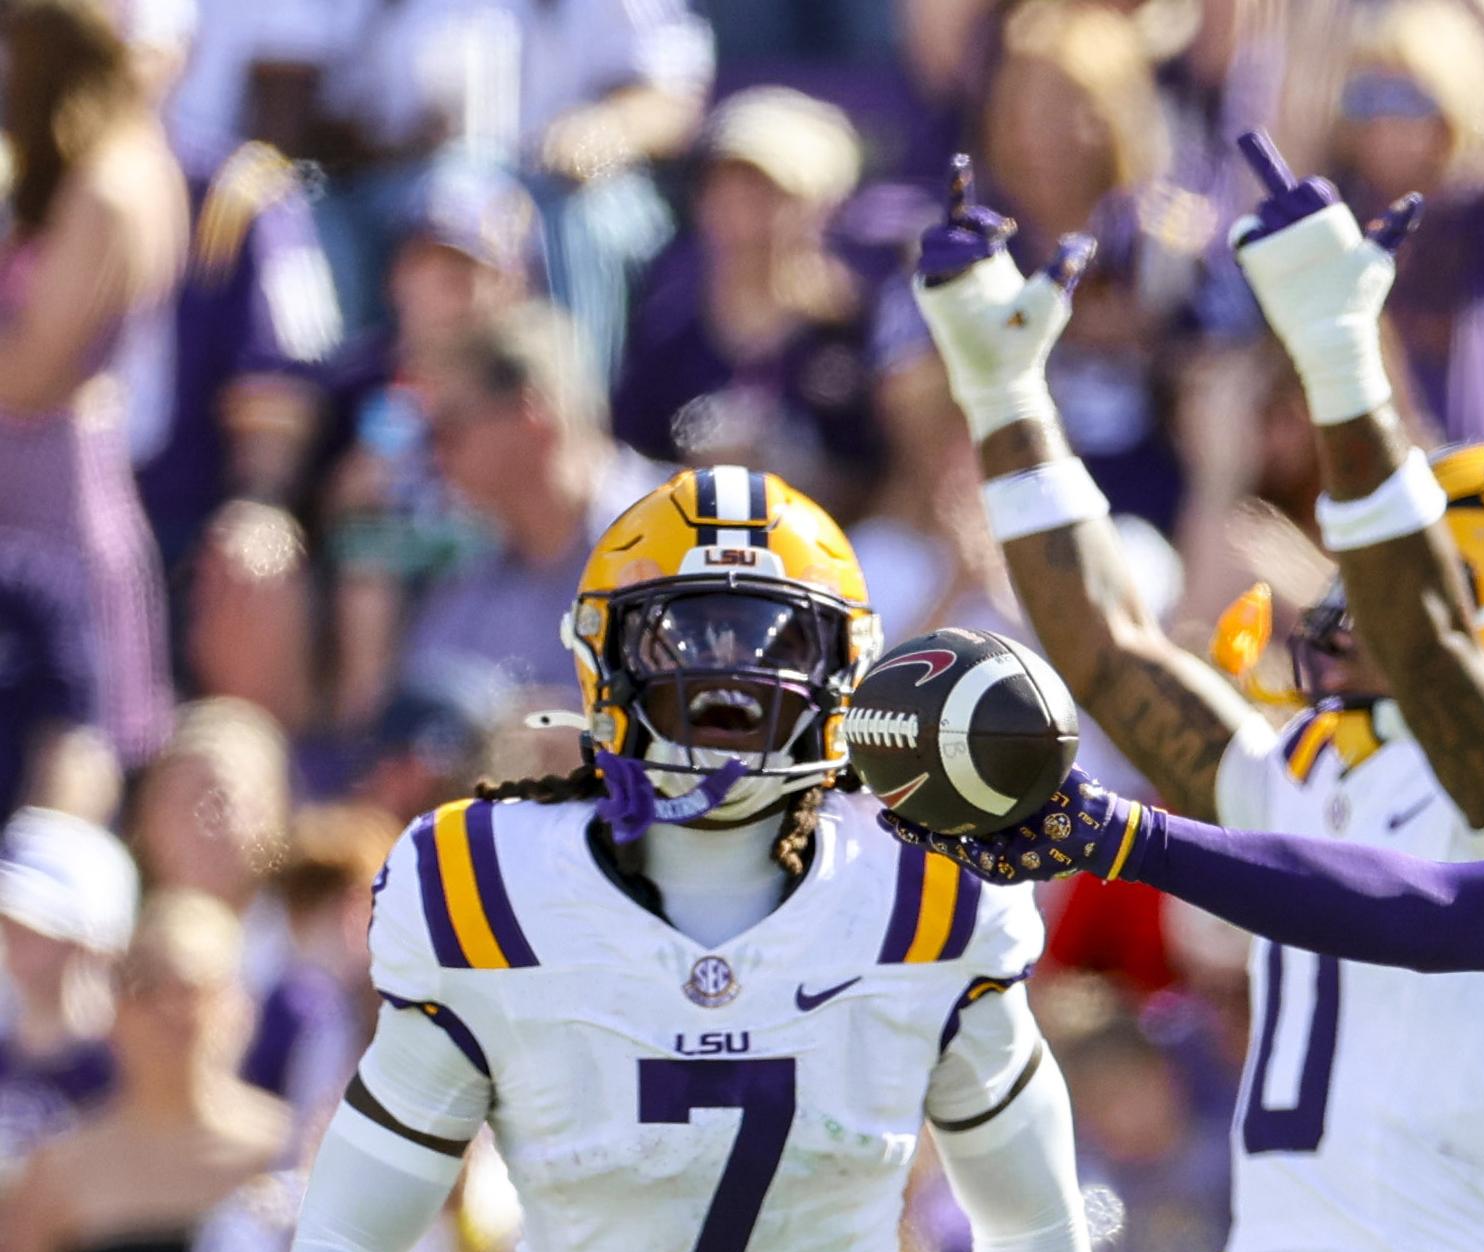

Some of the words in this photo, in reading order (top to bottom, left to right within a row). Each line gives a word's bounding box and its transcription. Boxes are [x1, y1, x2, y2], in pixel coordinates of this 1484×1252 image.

[704, 549, 756, 566] LSU
[1079, 812, 1099, 830] LSU
[1050, 848, 1071, 865] LSU
[694, 958, 732, 996] SEC
[675, 1031, 750, 1055] LSU
